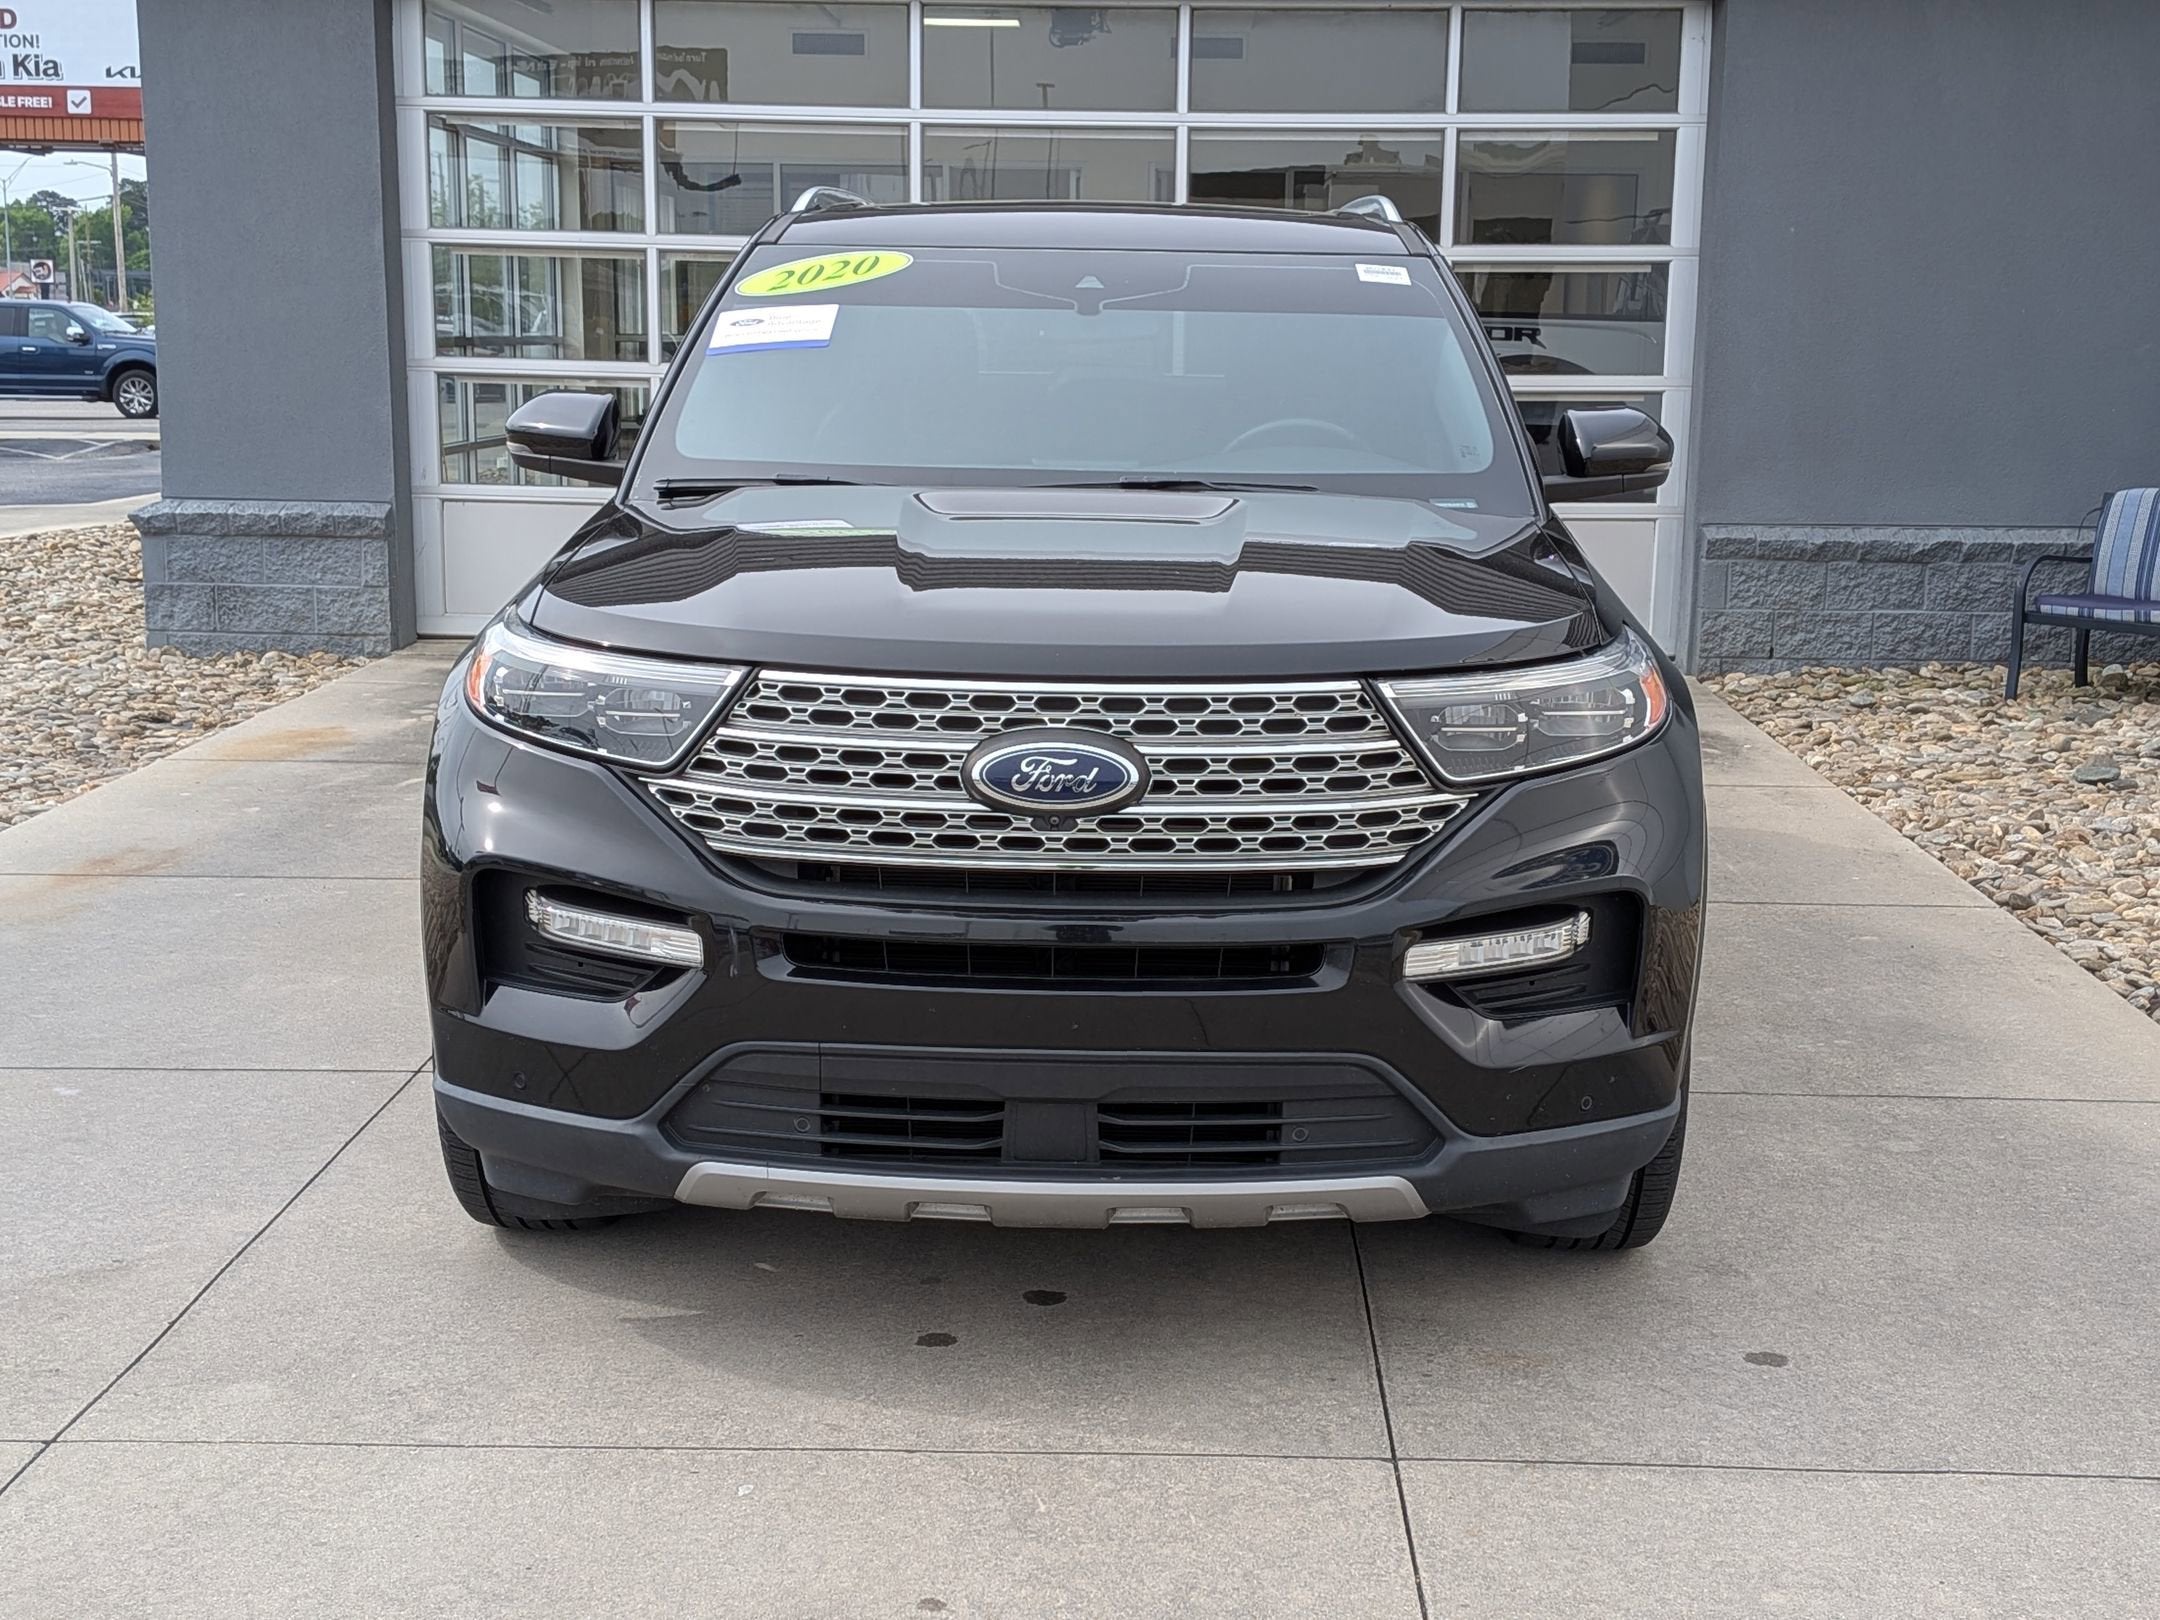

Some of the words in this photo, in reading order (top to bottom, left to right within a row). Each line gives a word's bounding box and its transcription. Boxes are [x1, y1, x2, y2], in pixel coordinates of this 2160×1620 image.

[0, 34, 40, 49] ION!
[12, 54, 62, 79] Kia
[0, 95, 16, 108] LE
[17, 96, 52, 108] FREE!
[766, 255, 880, 292] 2020
[1010, 756, 1099, 793] Ford
